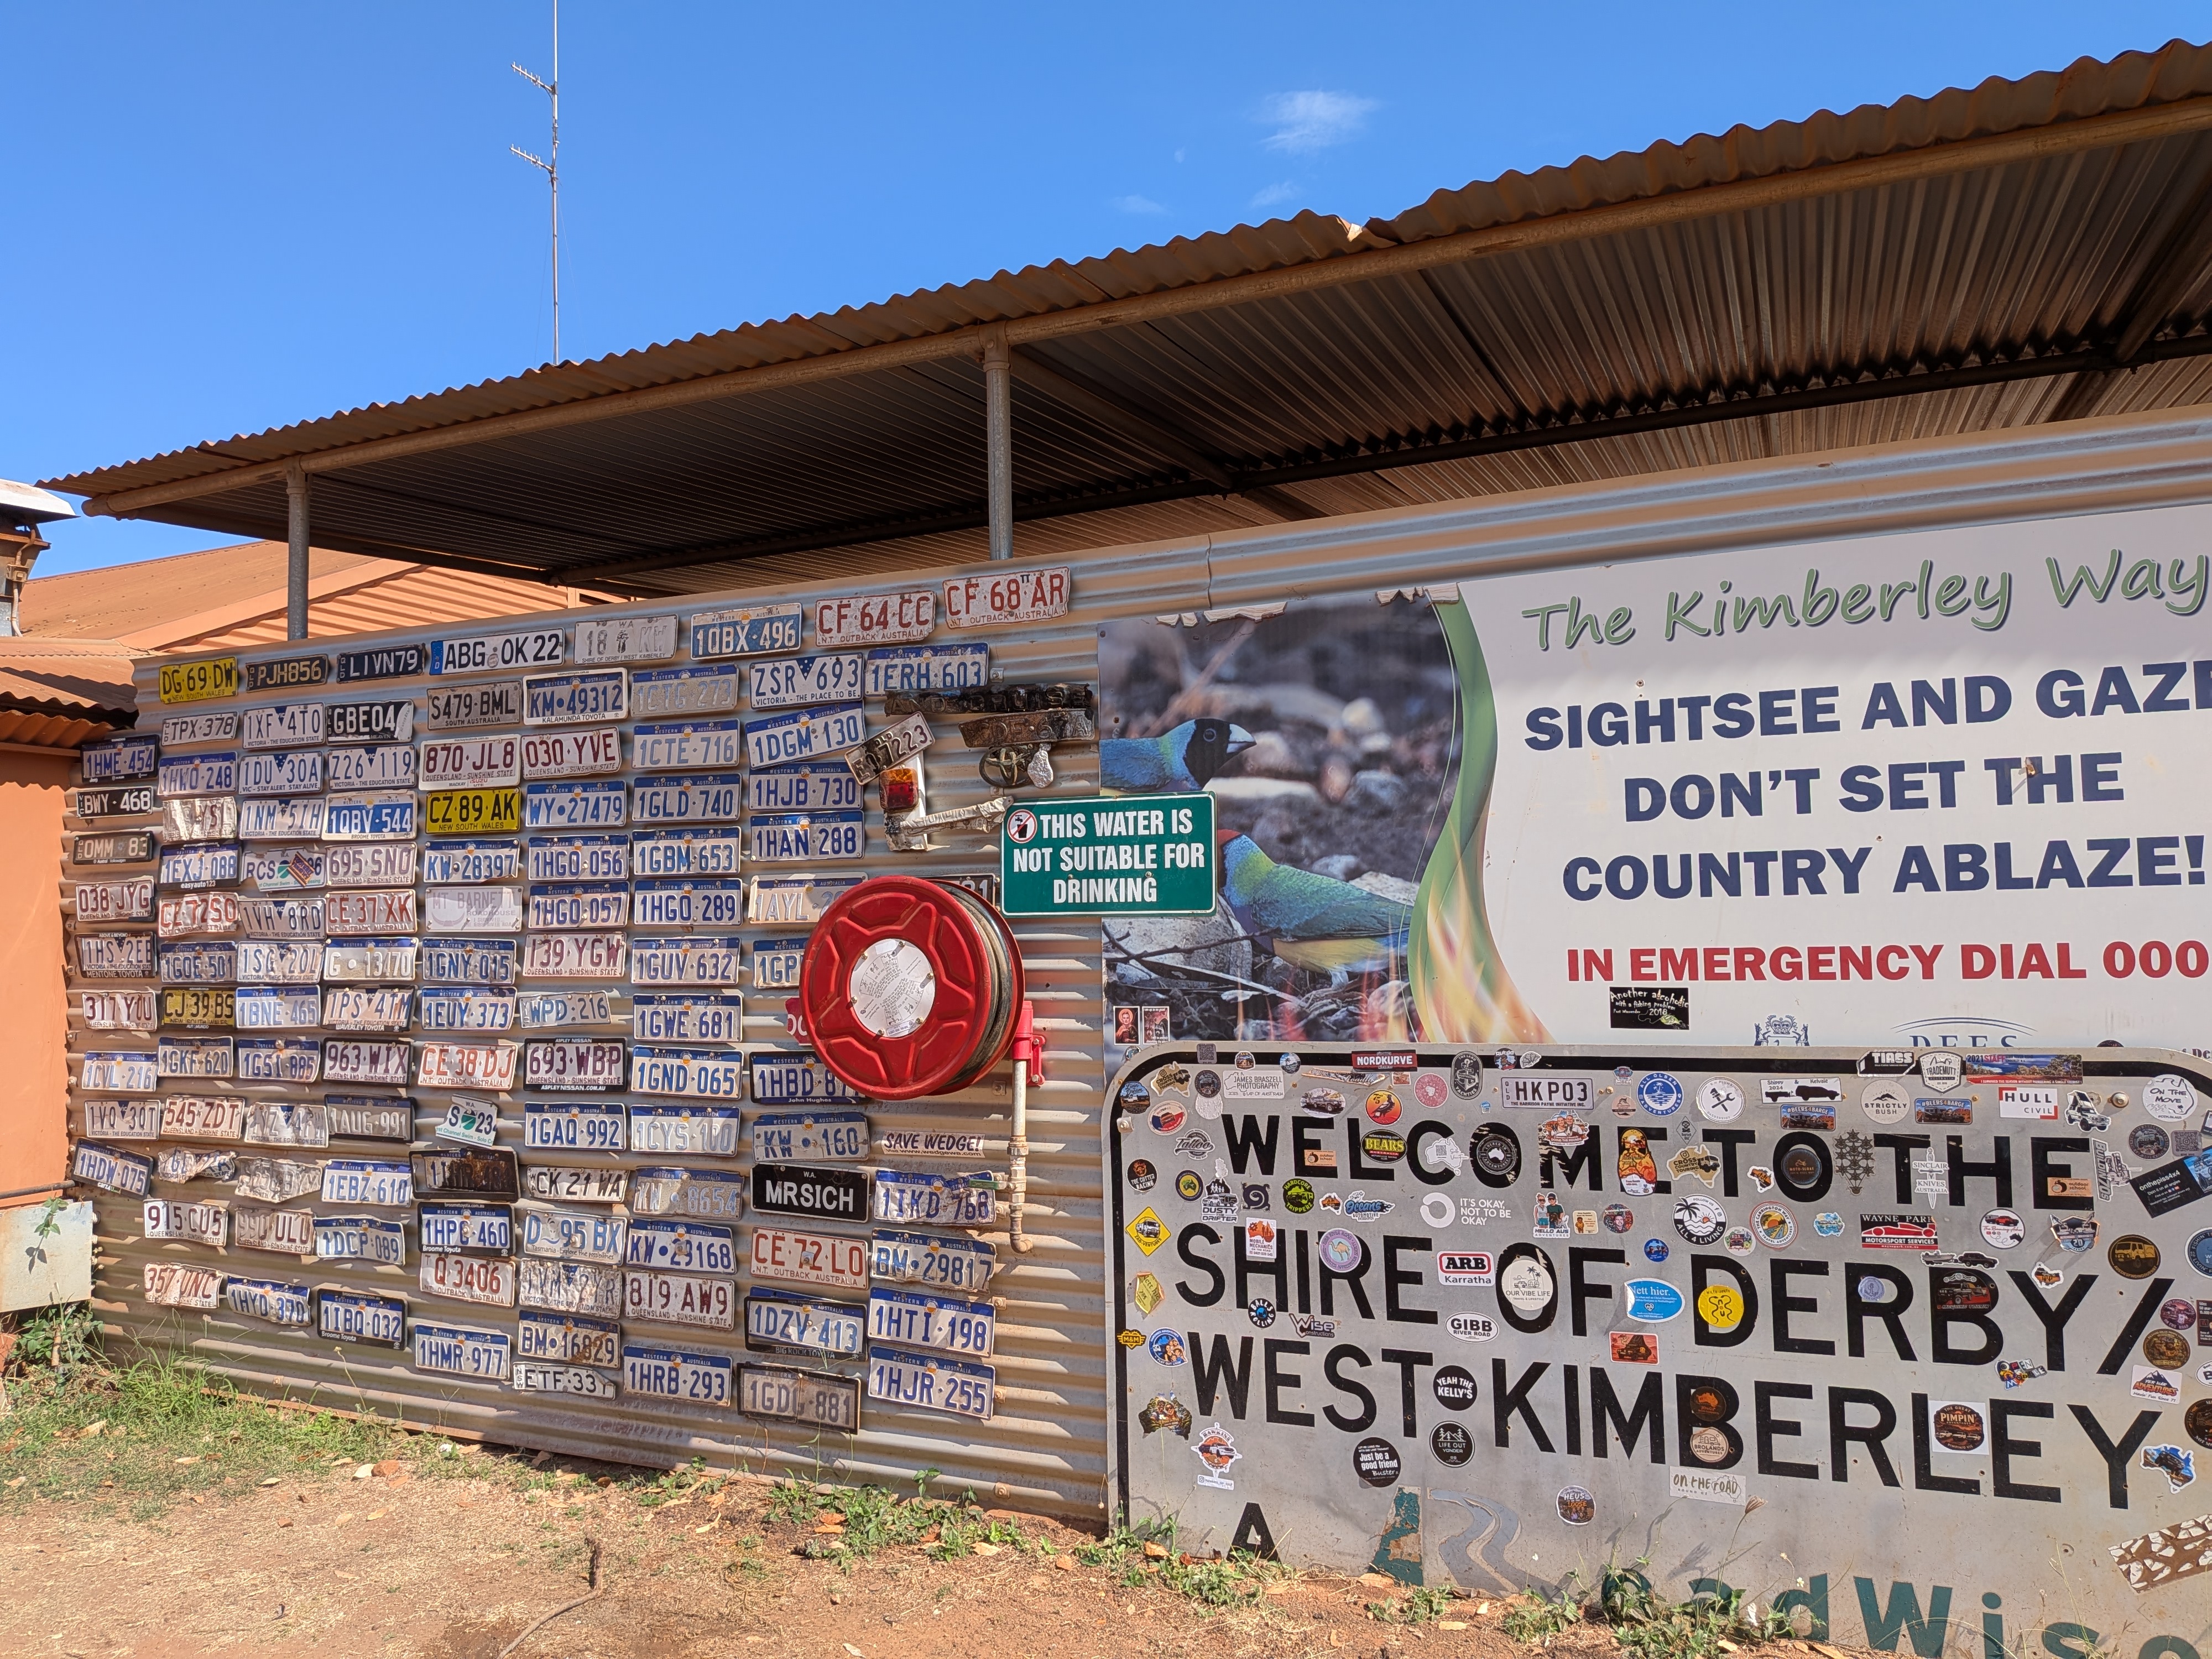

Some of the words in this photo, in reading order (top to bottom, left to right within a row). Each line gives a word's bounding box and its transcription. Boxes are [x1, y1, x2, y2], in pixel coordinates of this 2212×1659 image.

[1523, 596, 1636, 650] The
[1664, 559, 2012, 641] Kimberley
[2046, 549, 2209, 615] Way
[840, 634, 876, 643] OUTBACK
[881, 629, 925, 640] AUSTRALIA
[444, 641, 486, 670] ABG
[501, 637, 529, 665] OK
[533, 634, 560, 662] 22
[257, 660, 322, 686] PJH856
[755, 665, 796, 697] ZSR
[817, 659, 859, 690] 693
[1524, 686, 1841, 751] SIGHTSEE
[1861, 675, 2013, 731] AND
[380, 751, 412, 778] 119
[467, 771, 495, 780] SUNSHINE
[1839, 760, 1965, 813] SET
[1984, 752, 2125, 806] THE
[247, 805, 276, 831] 1NM
[1040, 813, 1086, 839] THIS
[1093, 810, 1164, 837] WATER
[1172, 809, 1192, 834] IS
[1013, 848, 1052, 872] NOT
[1060, 844, 1157, 872] SUITABLE
[1165, 843, 1204, 869] FOR
[1562, 847, 1874, 901] COUNTRY
[1892, 834, 2205, 894] ABLAZE!
[1053, 878, 1157, 904] DRINKING
[243, 906, 275, 930] 1VH
[289, 906, 321, 930] 8RD
[1567, 948, 1614, 982] IN
[1629, 943, 1944, 982] EMERGENCY
[1960, 941, 2087, 979] DIAL
[2102, 940, 2209, 979] 000
[1610, 988, 1647, 1002] Another
[1654, 1002, 1676, 1010] problem
[1357, 1056, 1413, 1065] NORDKURVE
[1926, 1066, 1957, 1076] TRADEMUTT
[2004, 1092, 2052, 1103] HULL
[885, 1133, 920, 1149] SAVE
[925, 1134, 981, 1151] WEDGE!
[1365, 1138, 1405, 1152] BEARS
[1221, 1114, 1672, 1194] WELCOME
[1702, 1128, 1833, 1203] TO
[1873, 1133, 2094, 1211] THE
[536, 1172, 562, 1196] CK
[566, 1172, 591, 1196] 21
[598, 1172, 622, 1198] WA
[765, 1180, 854, 1212] MRSICH
[1460, 1208, 1481, 1217] NOT
[1499, 1209, 1511, 1218] BE
[1461, 1216, 1487, 1225] OKAY
[1445, 1257, 1486, 1270] ARB
[774, 1269, 810, 1280] OUTBACK
[816, 1273, 858, 1286] AUSTRALIA
[1175, 1222, 1438, 1324] SHIRE
[1495, 1242, 1626, 1337] OF
[1444, 1275, 1492, 1284] Karratha
[1451, 1318, 1493, 1332] GIBB
[1438, 1386, 1473, 1399] KELLY'S
[1187, 1331, 1433, 1438] WEST
[1492, 1357, 2163, 1510] KIMBERLEY
[1694, 1444, 1725, 1453] BROLANDS
[1361, 1461, 1378, 1470] good
[1379, 1459, 1398, 1468] friend
